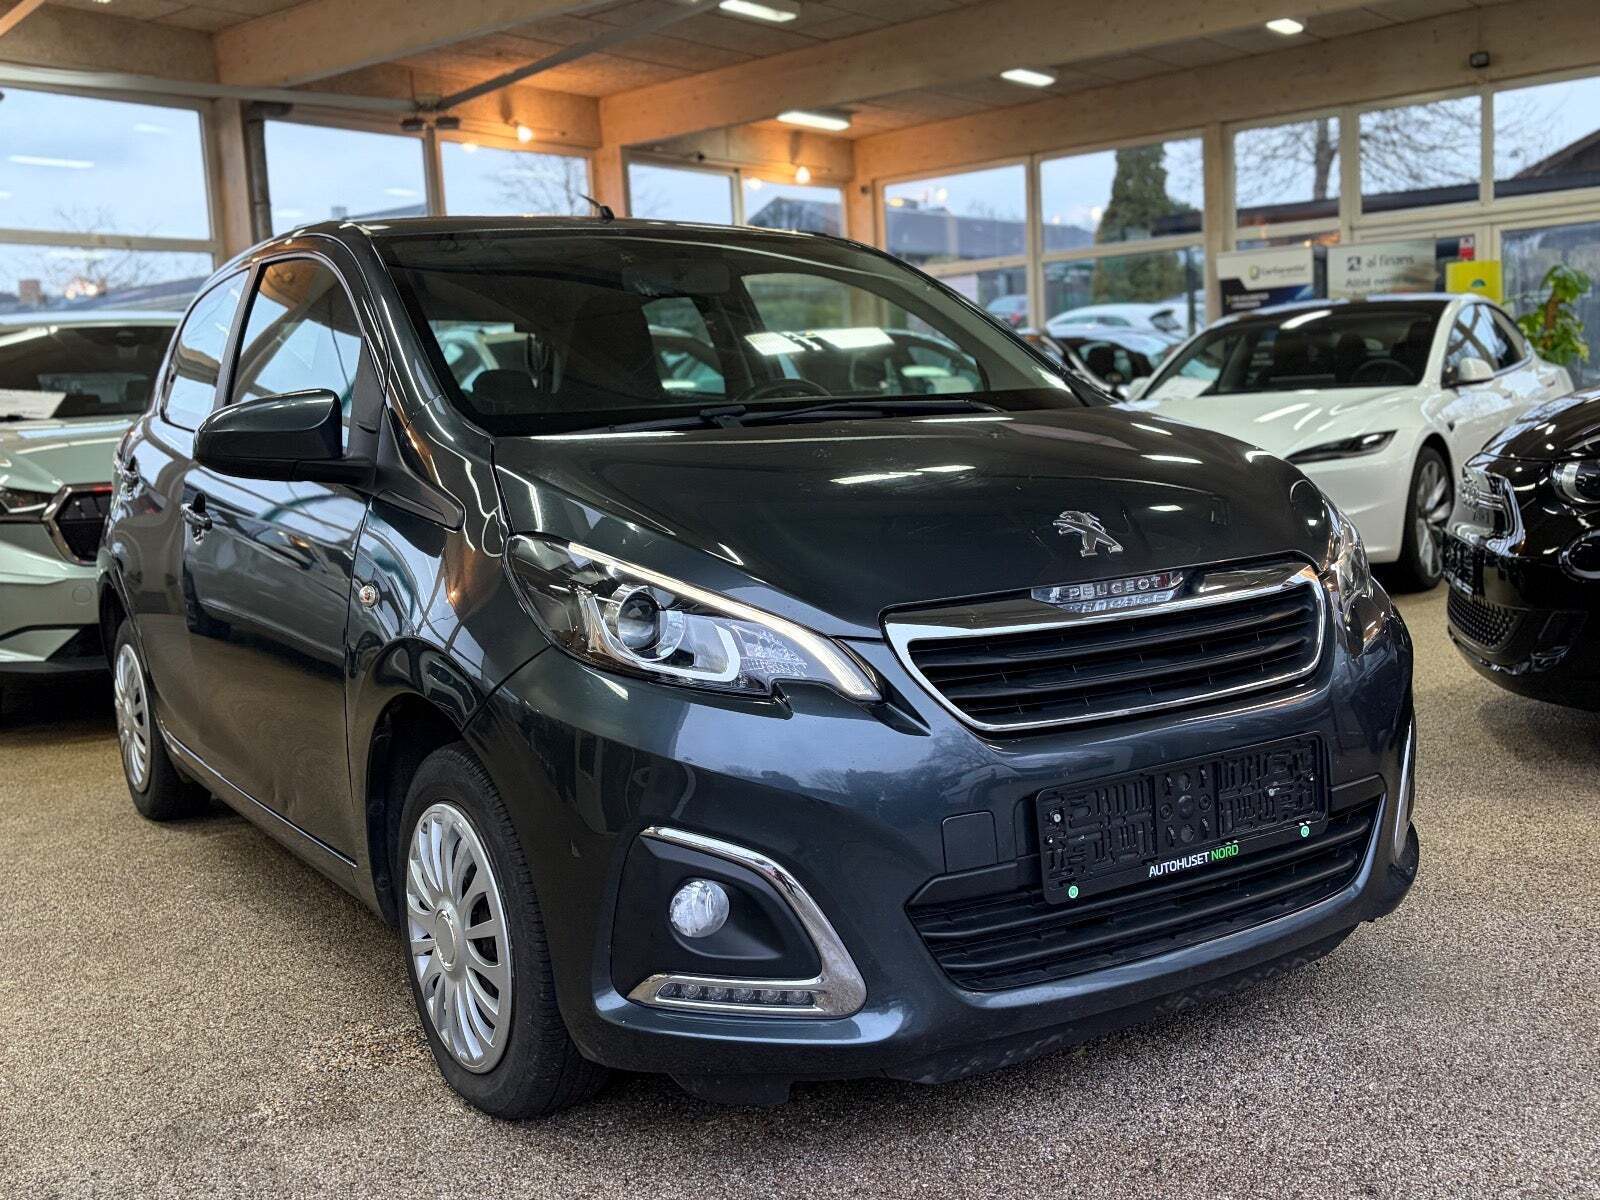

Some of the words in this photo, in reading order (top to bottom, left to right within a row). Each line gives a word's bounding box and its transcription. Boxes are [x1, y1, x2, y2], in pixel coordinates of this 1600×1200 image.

[1068, 576, 1161, 597] PEUGEOT
[1148, 851, 1210, 878] AUTOHUSET
[1211, 844, 1239, 861] NORD
